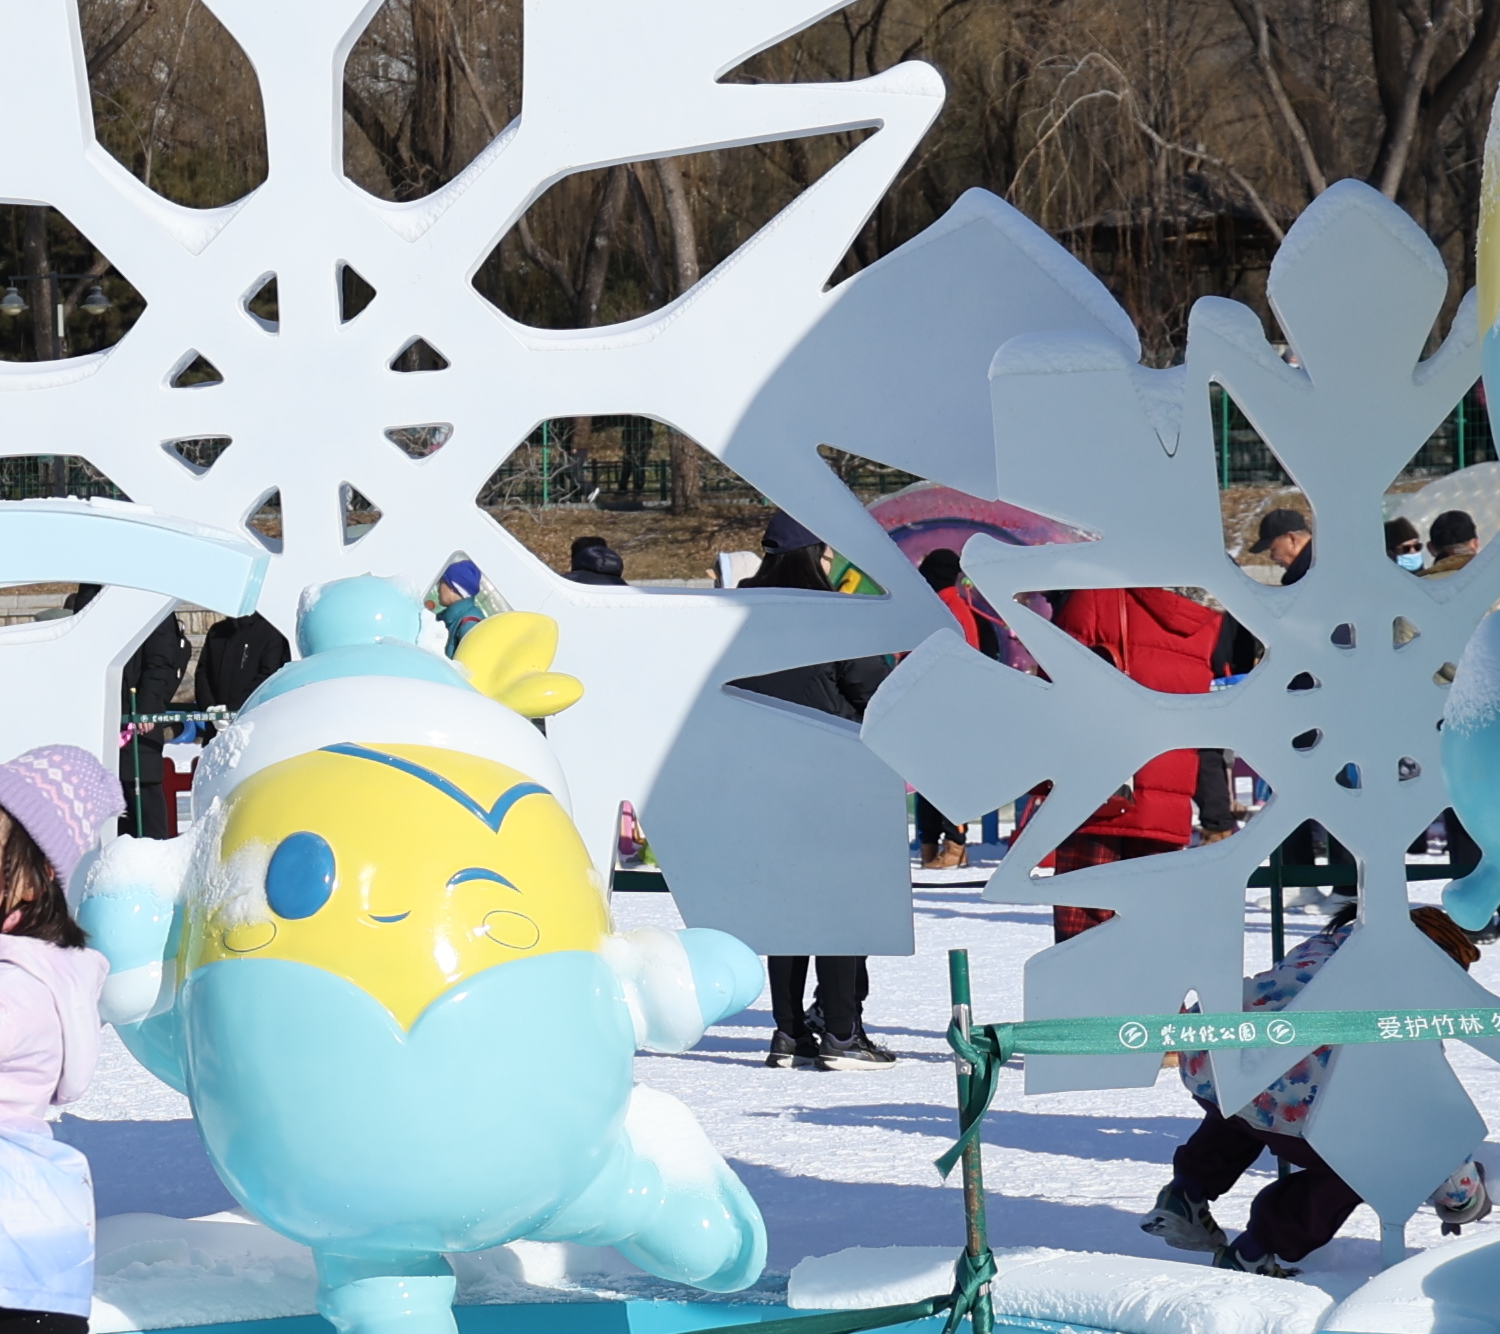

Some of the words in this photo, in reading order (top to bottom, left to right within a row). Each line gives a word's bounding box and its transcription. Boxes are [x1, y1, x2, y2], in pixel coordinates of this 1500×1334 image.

[1161, 1021, 1256, 1046] 紫竹院公园
[1377, 1014, 1485, 1040] 爱护竹林
